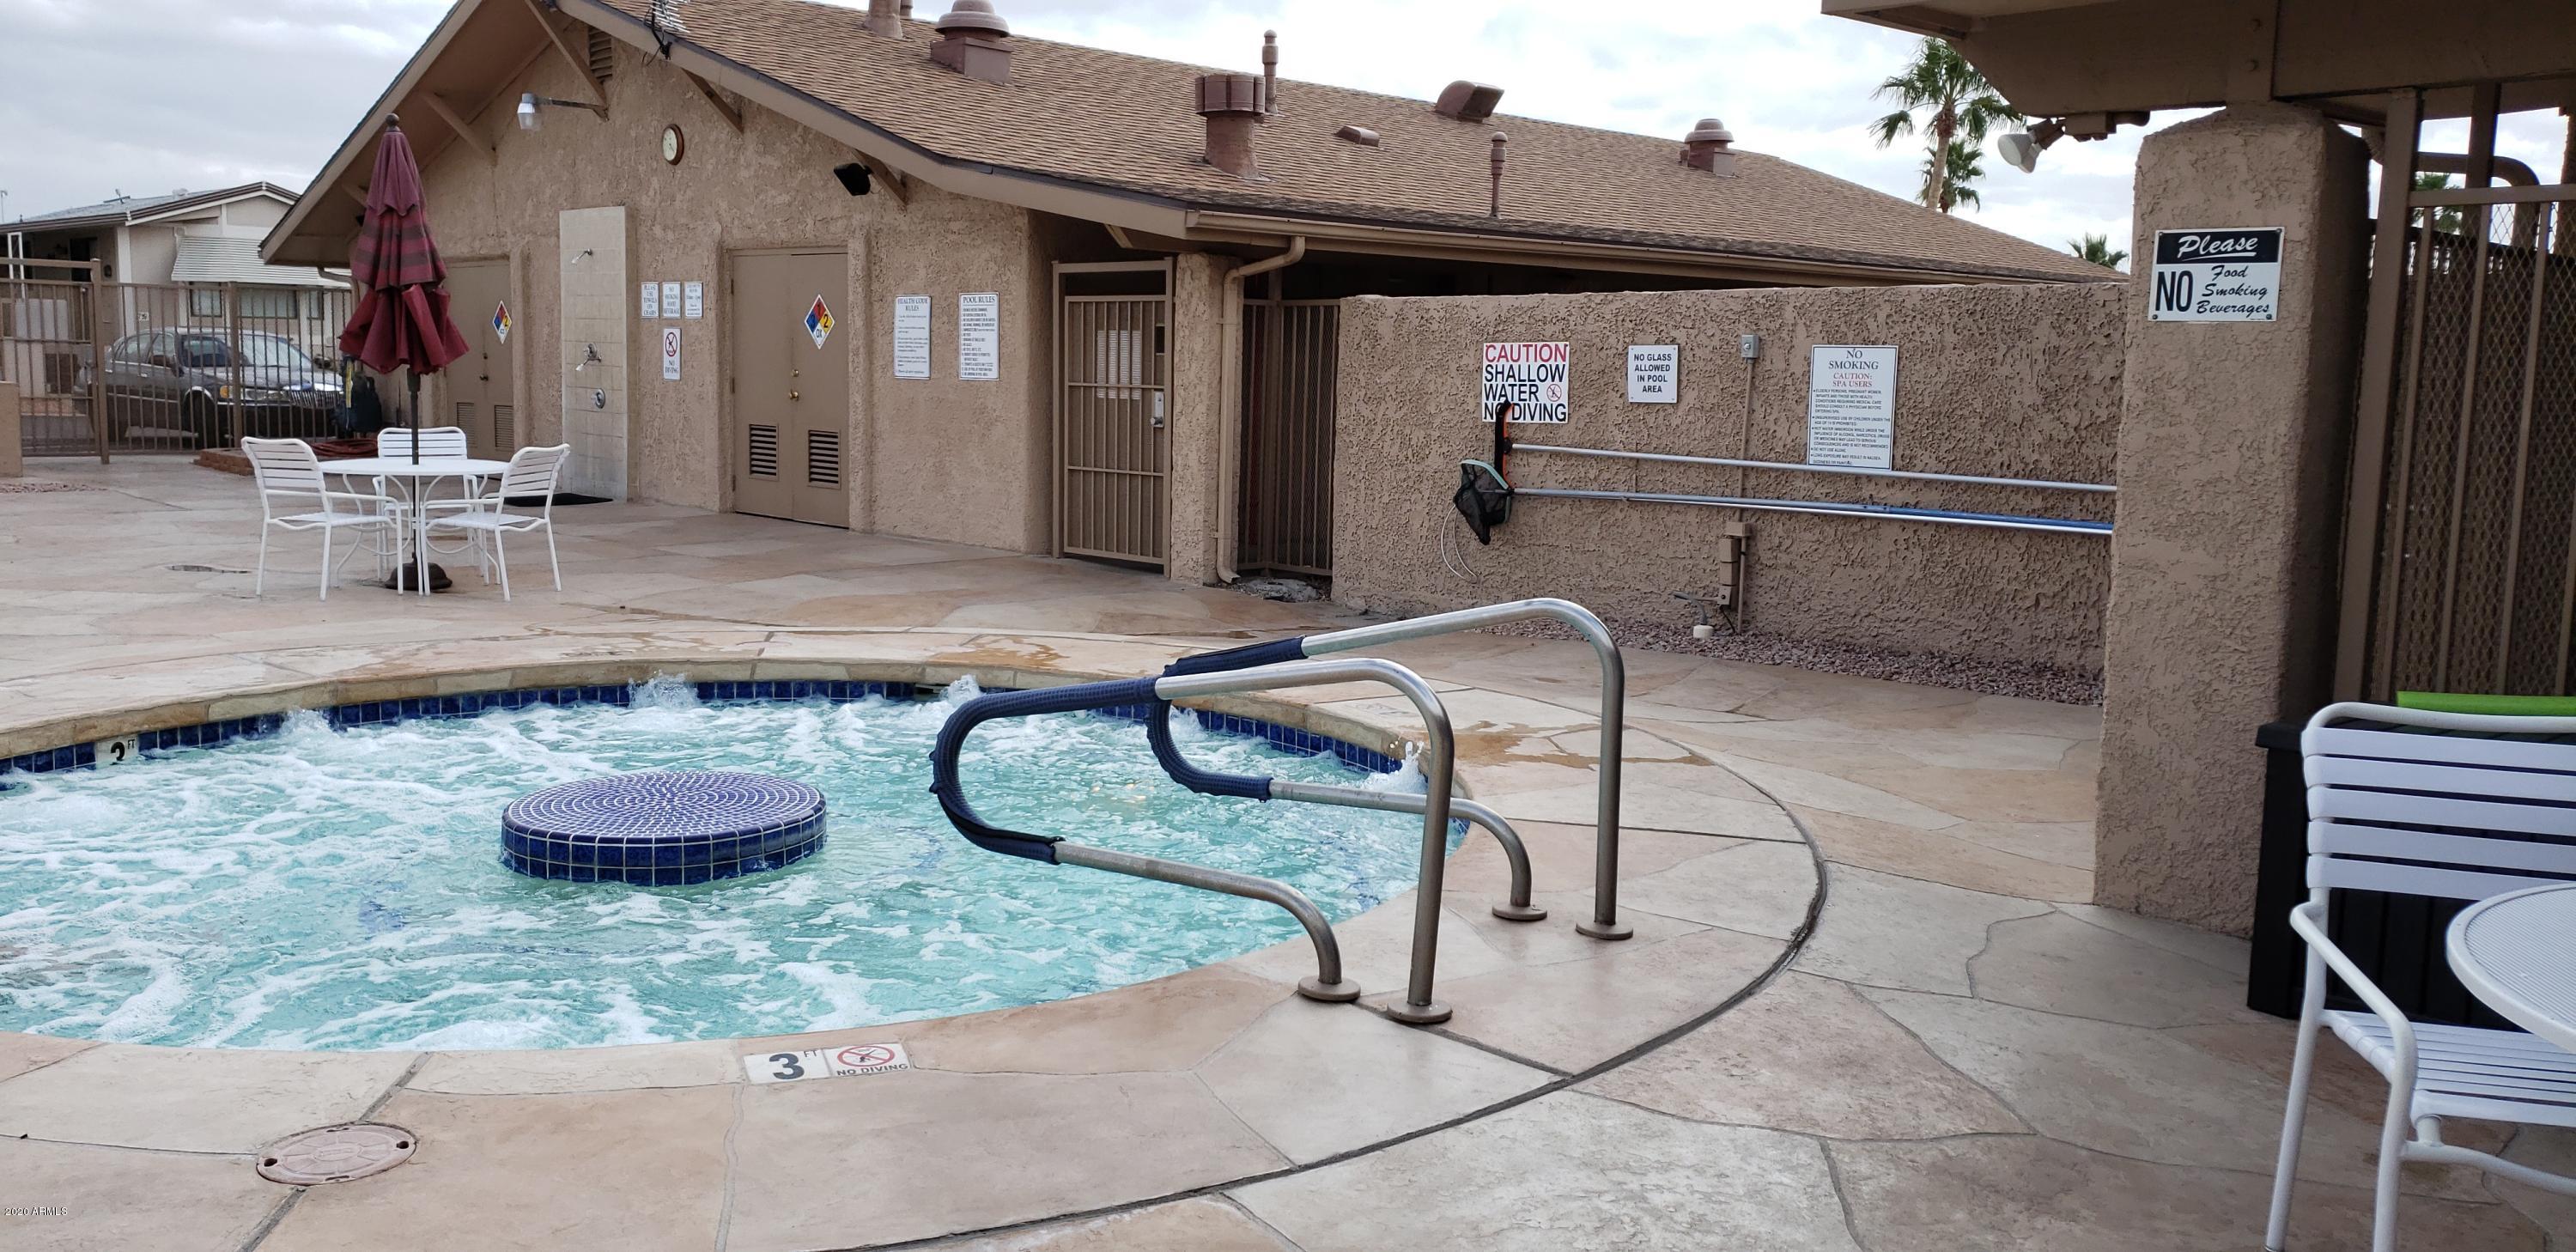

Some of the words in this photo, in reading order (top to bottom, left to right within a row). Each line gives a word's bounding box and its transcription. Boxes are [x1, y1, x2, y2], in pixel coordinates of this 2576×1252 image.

[2177, 234, 2258, 258] Please
[2211, 264, 2248, 281] Food
[2155, 270, 2194, 313] NO
[2202, 283, 2268, 301] Smoking
[2196, 300, 2269, 319] Beverages
[823, 313, 829, 328] 2
[1485, 343, 1567, 362] CAUTION
[1846, 349, 1862, 358] NO
[1485, 364, 1565, 382] SHALLOW
[1828, 361, 1879, 369] SMOKING
[1484, 383, 1540, 402] WATER
[1512, 403, 1567, 422] DIVING
[127, 738, 135, 749] FT
[769, 1053, 805, 1080] 3
[836, 1068, 856, 1077] NO
[860, 1062, 908, 1075] DIVING
